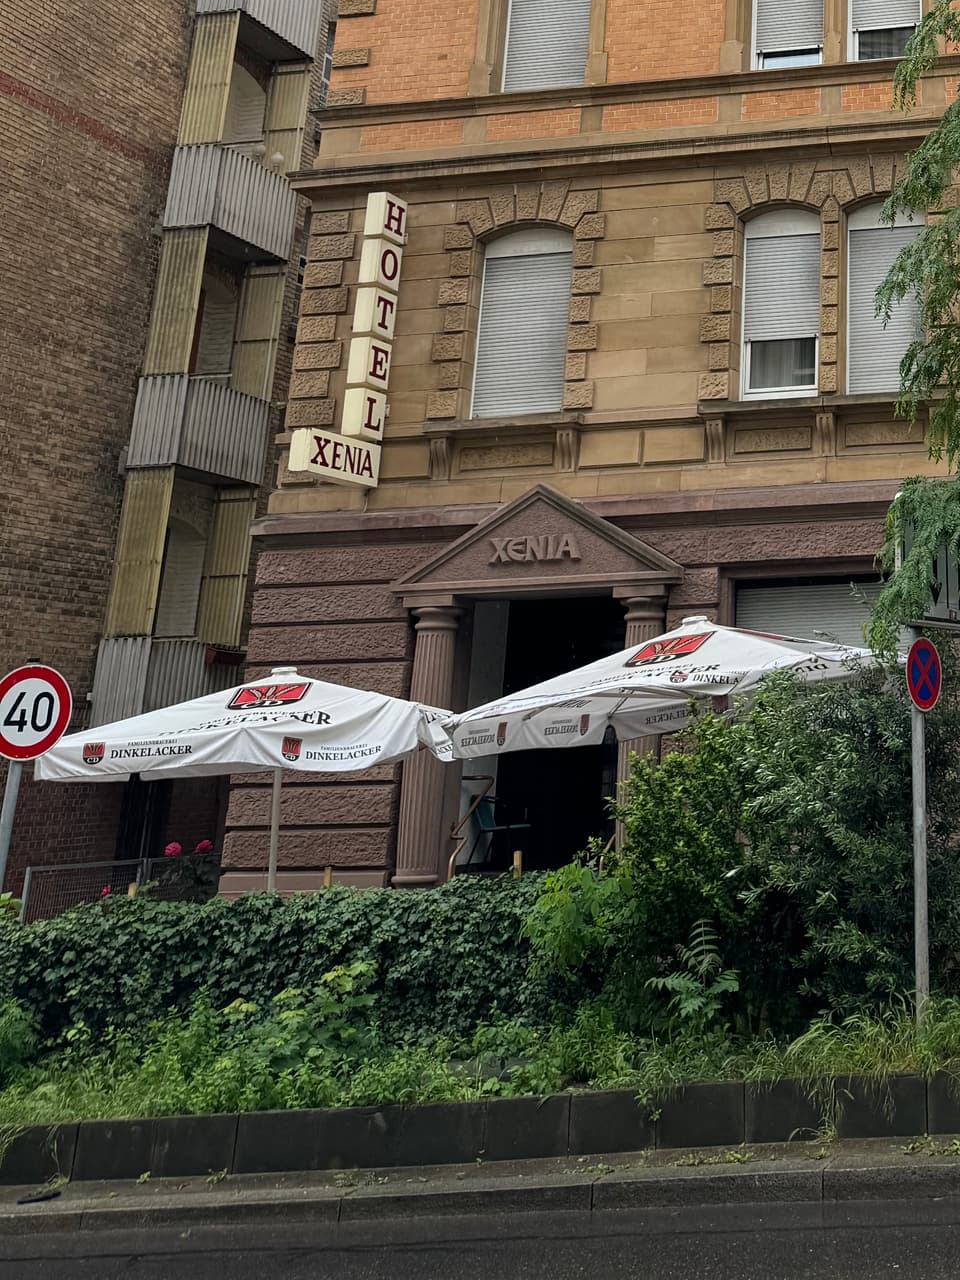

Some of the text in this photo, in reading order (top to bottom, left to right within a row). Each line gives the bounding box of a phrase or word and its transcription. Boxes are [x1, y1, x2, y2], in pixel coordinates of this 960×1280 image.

[363, 200, 406, 434] HOTEL
[310, 435, 375, 479] XENIA
[488, 533, 583, 567] XENIA
[3, 691, 55, 733] 40
[110, 745, 193, 759] DINKELACKER
[306, 745, 382, 761] DINKELACKER
